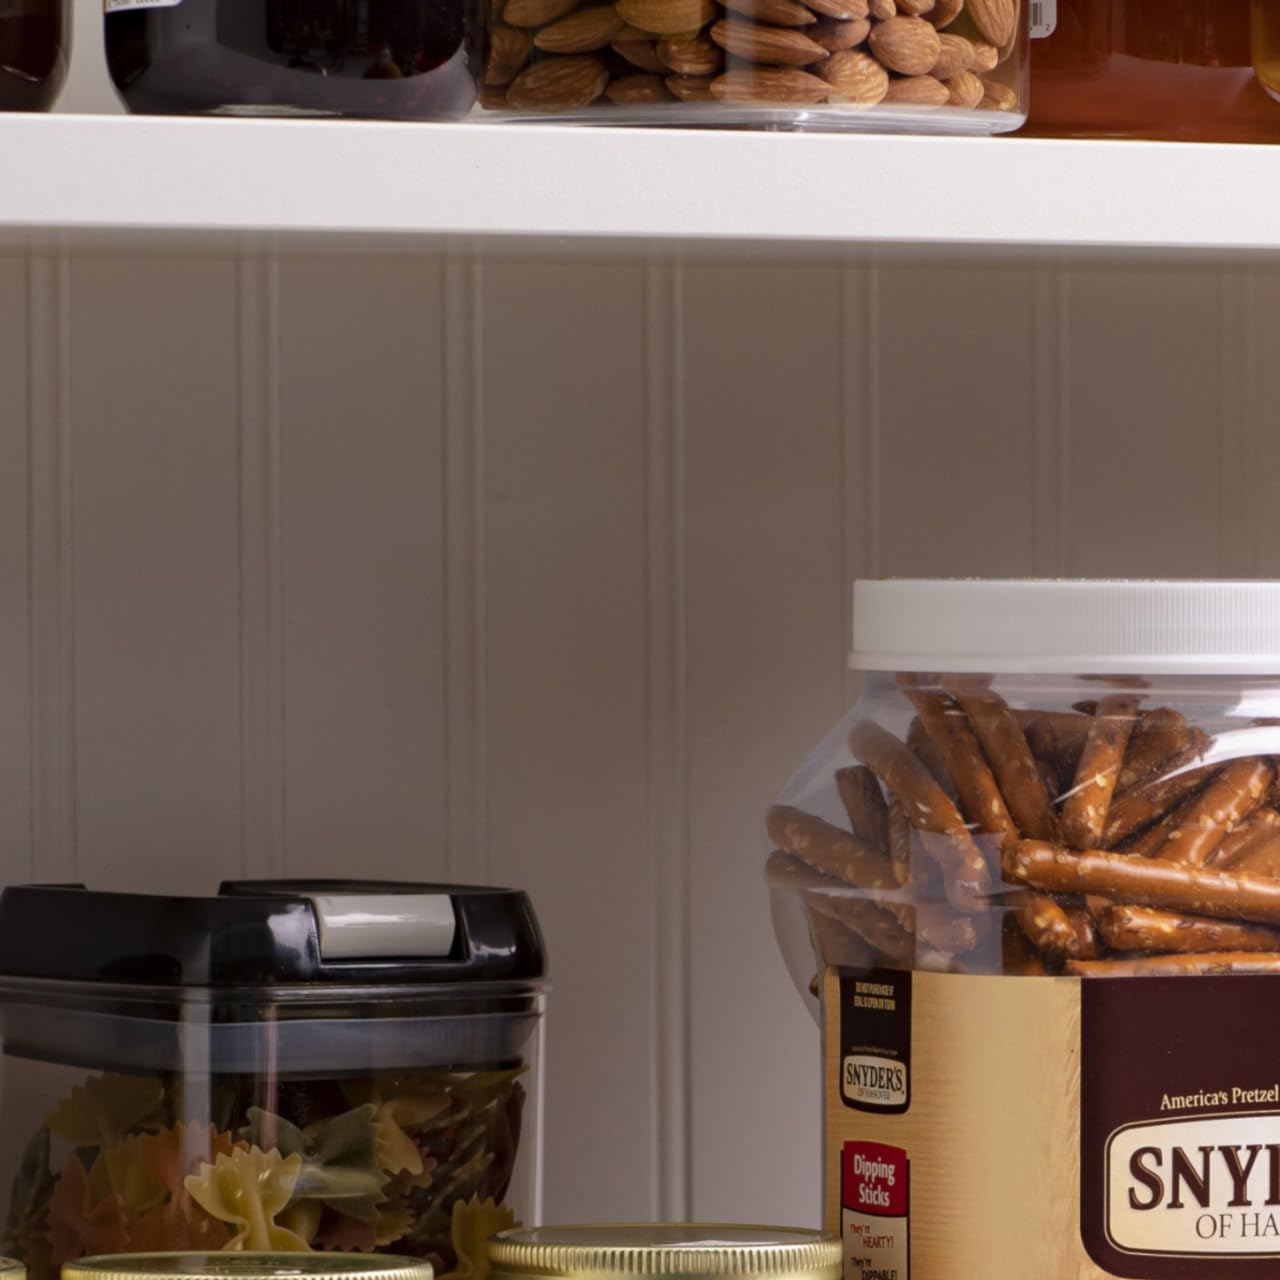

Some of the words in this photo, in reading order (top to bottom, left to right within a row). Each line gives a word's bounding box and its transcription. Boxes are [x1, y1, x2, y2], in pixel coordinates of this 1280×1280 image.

[847, 1063, 903, 1092] SNYDER'S
[1160, 1091, 1228, 1110] America's
[1232, 1084, 1279, 1104] Pretzel
[854, 1154, 895, 1186] Dipping
[859, 1184, 890, 1207] Sticks
[1195, 1214, 1232, 1239] OF
[863, 1236, 894, 1249] HEARTY!
